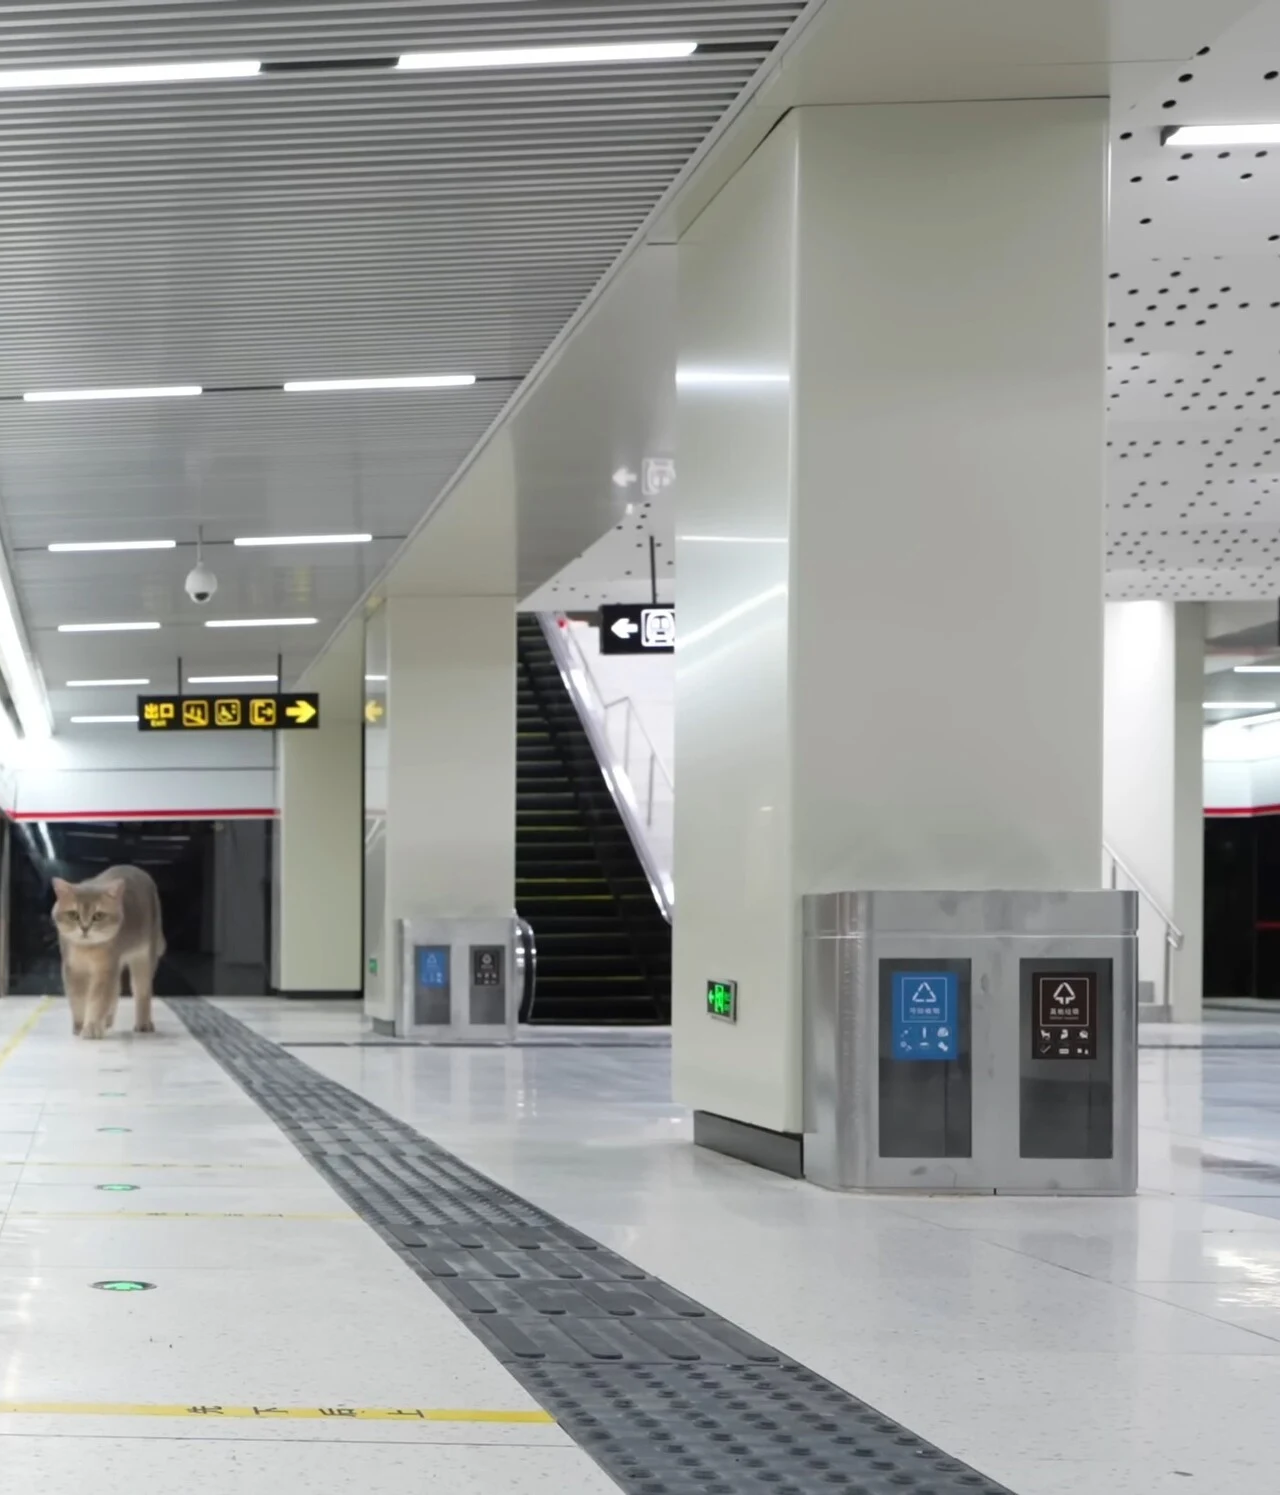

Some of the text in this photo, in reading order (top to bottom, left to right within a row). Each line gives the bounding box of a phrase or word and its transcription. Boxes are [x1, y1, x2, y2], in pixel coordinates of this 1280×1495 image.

[144, 702, 174, 719] 出口
[150, 719, 167, 727] Exit
[186, 1405, 425, 1418] 先下后上
